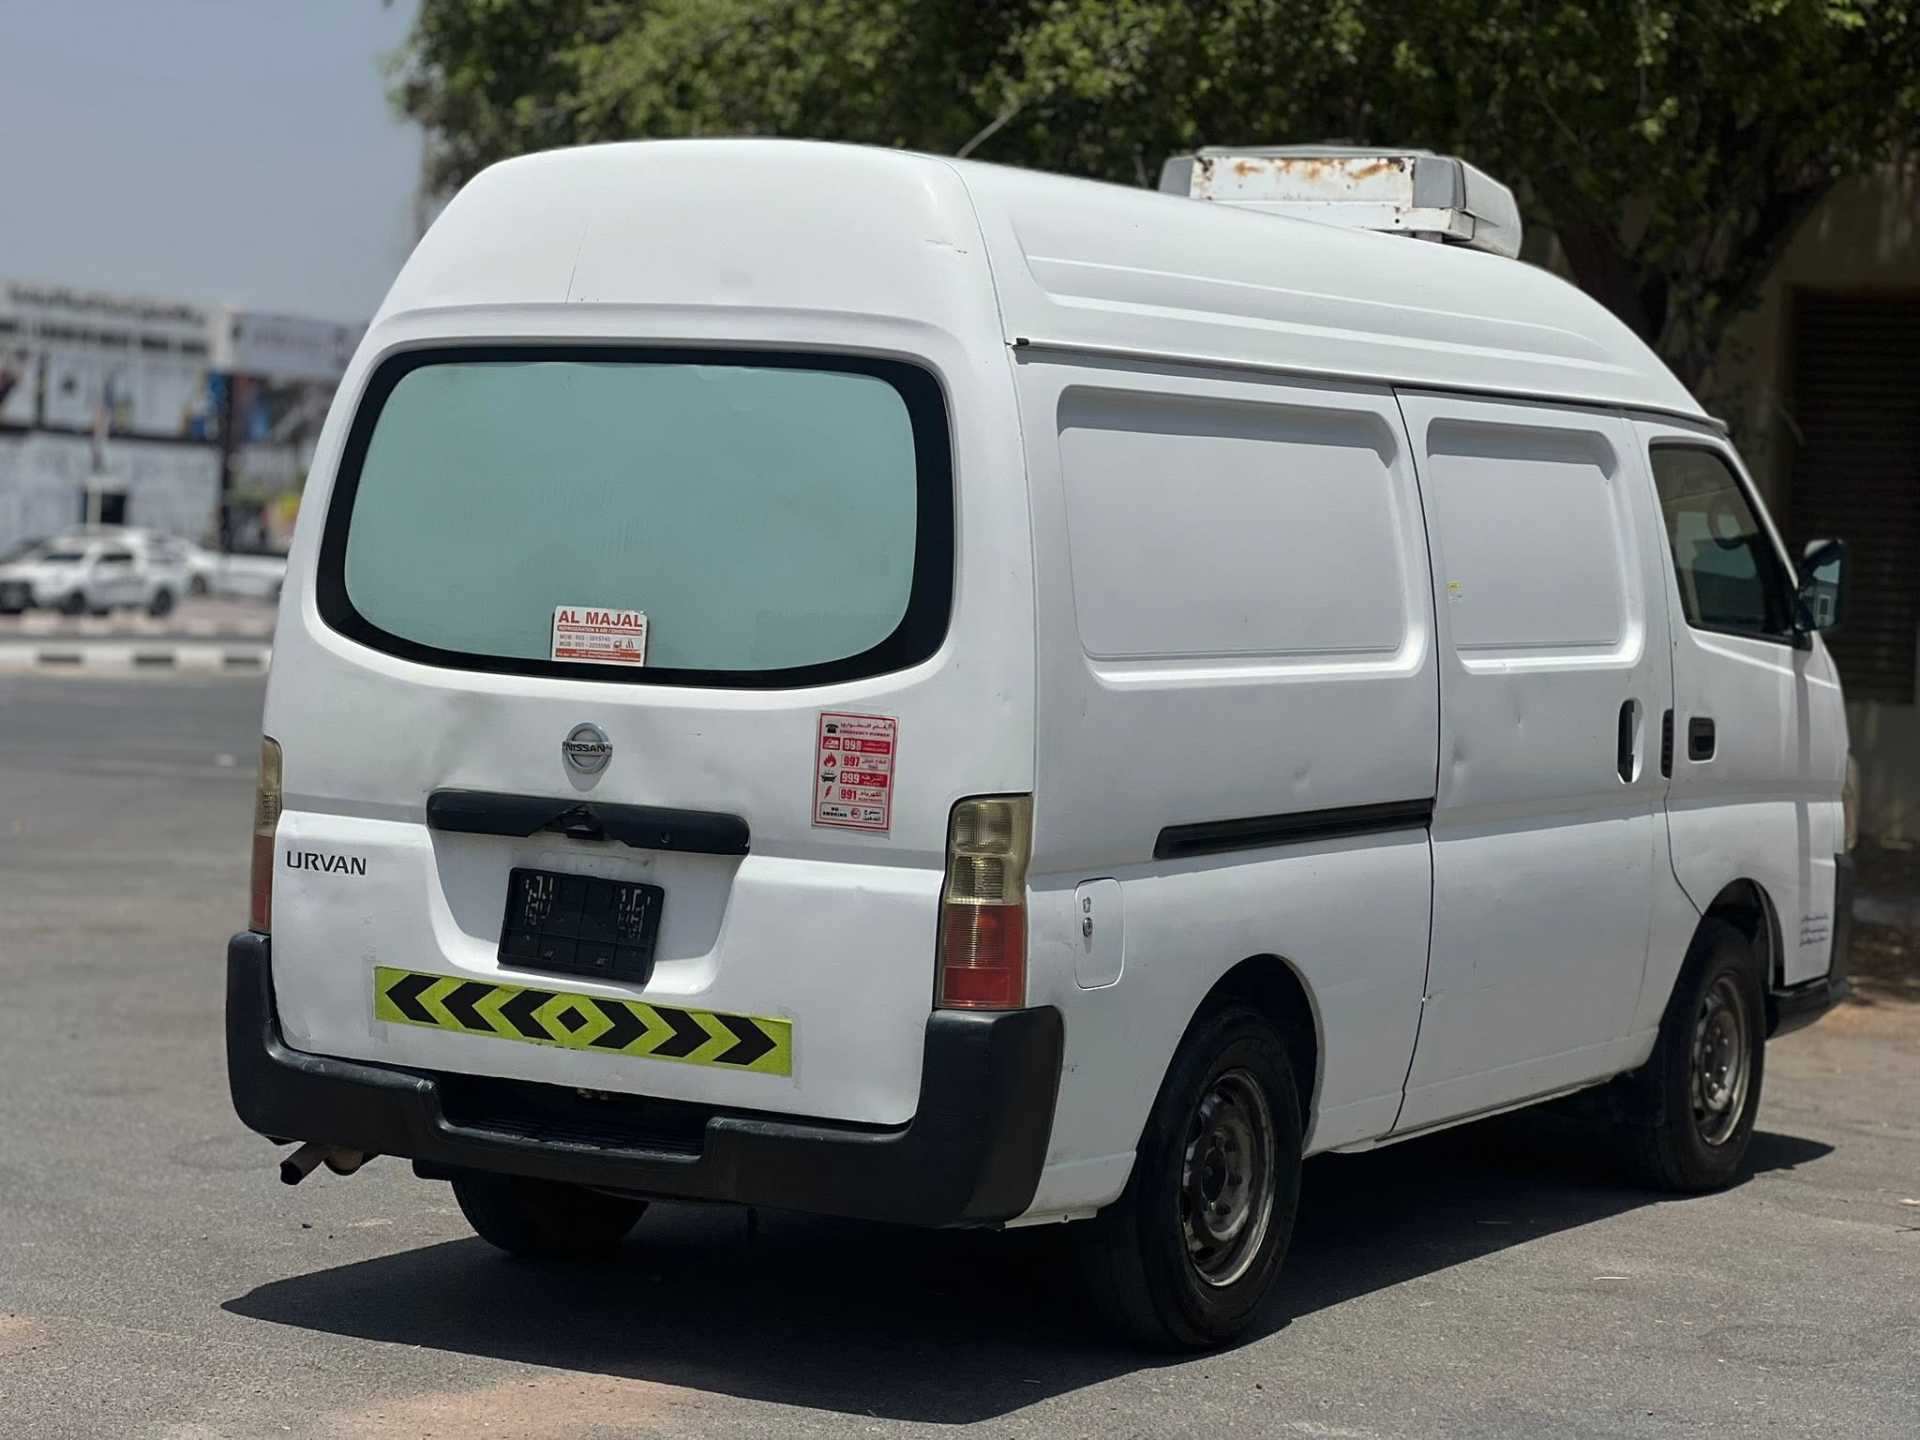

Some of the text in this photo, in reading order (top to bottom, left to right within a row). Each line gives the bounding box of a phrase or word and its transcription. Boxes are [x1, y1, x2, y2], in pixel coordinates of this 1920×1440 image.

[558, 610, 643, 628] AL MAJAL
[565, 743, 606, 753] NISSAN
[843, 754, 860, 767] 997
[841, 771, 860, 784] 999
[840, 788, 857, 801] 991
[286, 850, 367, 876] URVAN
